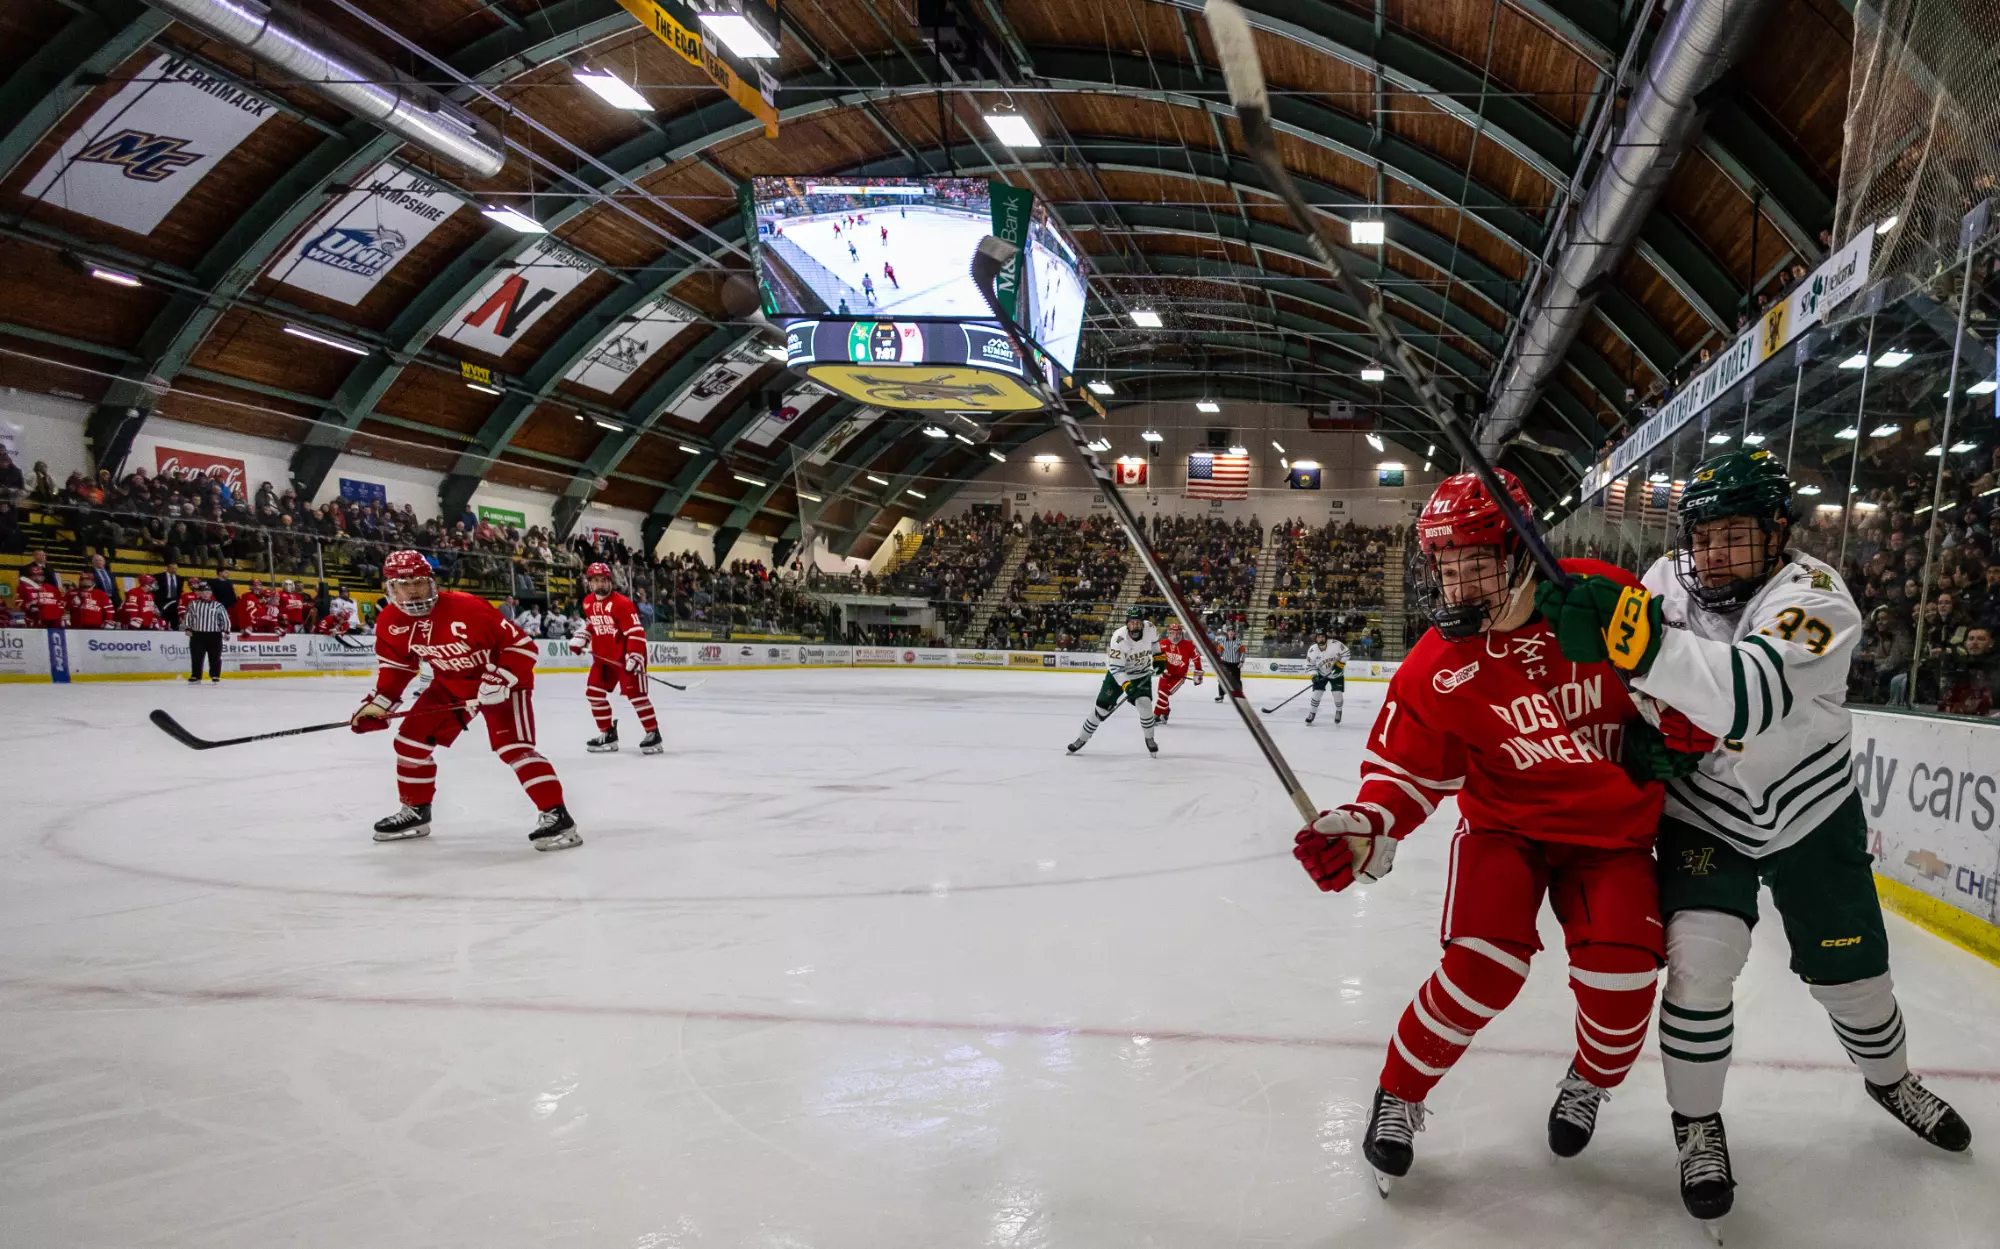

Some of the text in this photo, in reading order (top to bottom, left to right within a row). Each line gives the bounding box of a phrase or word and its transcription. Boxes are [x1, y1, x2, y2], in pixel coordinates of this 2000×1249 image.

[655, 9, 673, 42] THE
[159, 56, 271, 117] MERRIMACK
[406, 179, 443, 198] NEW
[368, 180, 445, 222] HAMPSHIRE
[318, 231, 393, 269] UNH
[1000, 196, 1020, 293] M& Bank
[307, 247, 376, 276] WILDCATS
[982, 345, 1014, 359] SUMMIT
[1719, 334, 1754, 390] HOCKEY
[1433, 500, 1452, 514] 71
[1686, 494, 1718, 508] CCM
[1425, 525, 1453, 538] BOSTON
[604, 602, 613, 613] A
[450, 621, 468, 640] C
[501, 619, 519, 638] 7
[52, 632, 64, 672] CCM
[88, 639, 152, 651] Scooore!
[319, 643, 341, 653] UVM
[410, 639, 471, 659] BOSTON
[706, 645, 722, 658] VIP
[1014, 655, 1039, 664] Milton
[1110, 649, 1122, 659] 22
[1088, 661, 1106, 669] Lynch
[1455, 664, 1477, 679] HOCKEY
[1456, 673, 1473, 684] EAST
[1378, 700, 1396, 747] 1
[1908, 762, 1997, 832] cars
[1821, 936, 1862, 948] CCM
